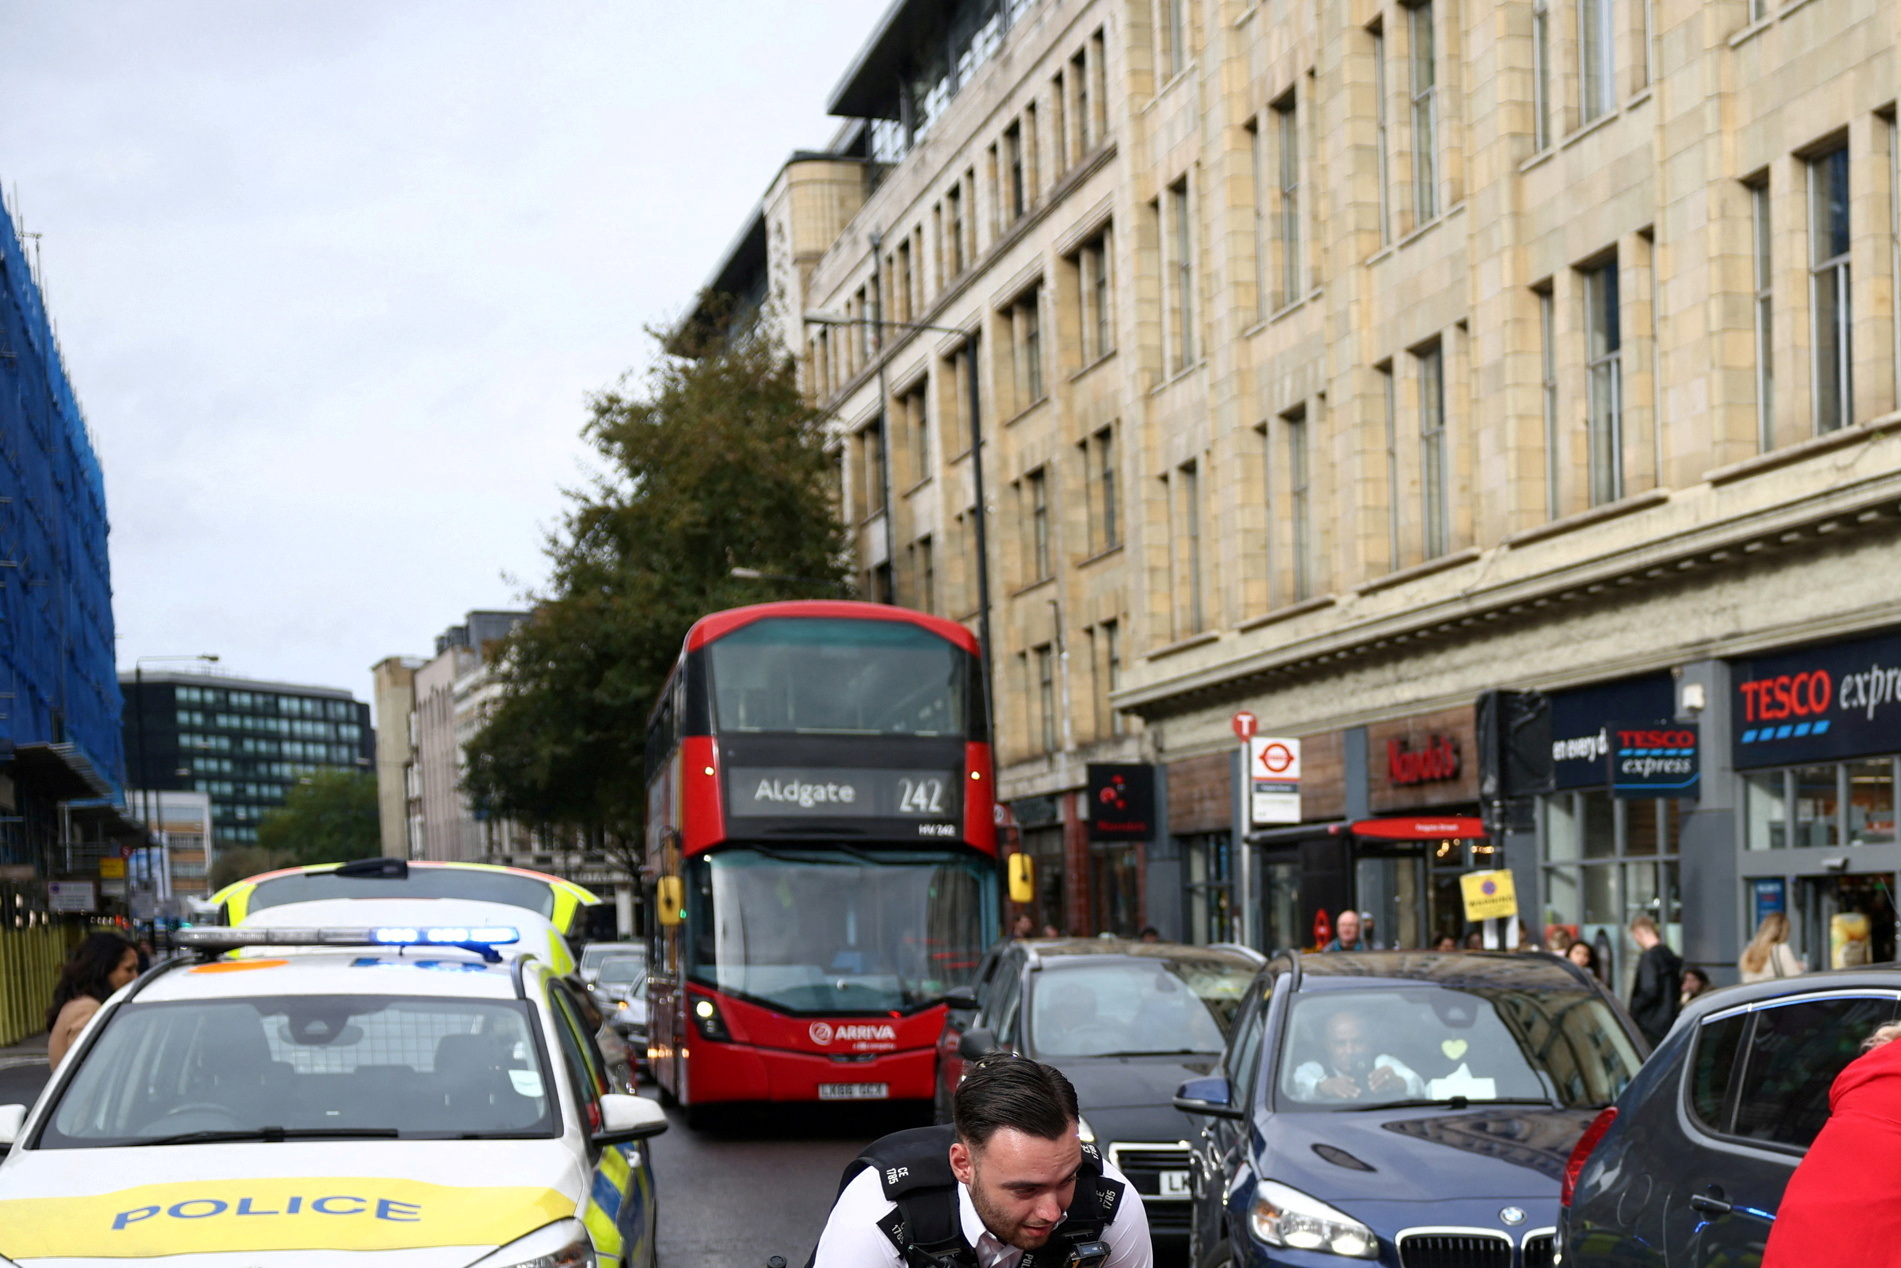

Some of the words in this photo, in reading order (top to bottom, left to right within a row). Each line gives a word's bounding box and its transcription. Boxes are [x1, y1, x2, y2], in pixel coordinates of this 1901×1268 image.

[1739, 668, 1833, 722] TESCO
[1236, 714, 1253, 736] T
[1617, 730, 1696, 748] TESCO
[1621, 757, 1692, 778] express
[754, 779, 856, 808] Aldgate
[899, 778, 943, 813] 242
[835, 1025, 897, 1040] ARRIVA
[886, 1167, 899, 1185] 1785
[897, 1166, 909, 1178] CE
[1102, 1189, 1116, 1210] 1785
[111, 1196, 422, 1231] POLICE
